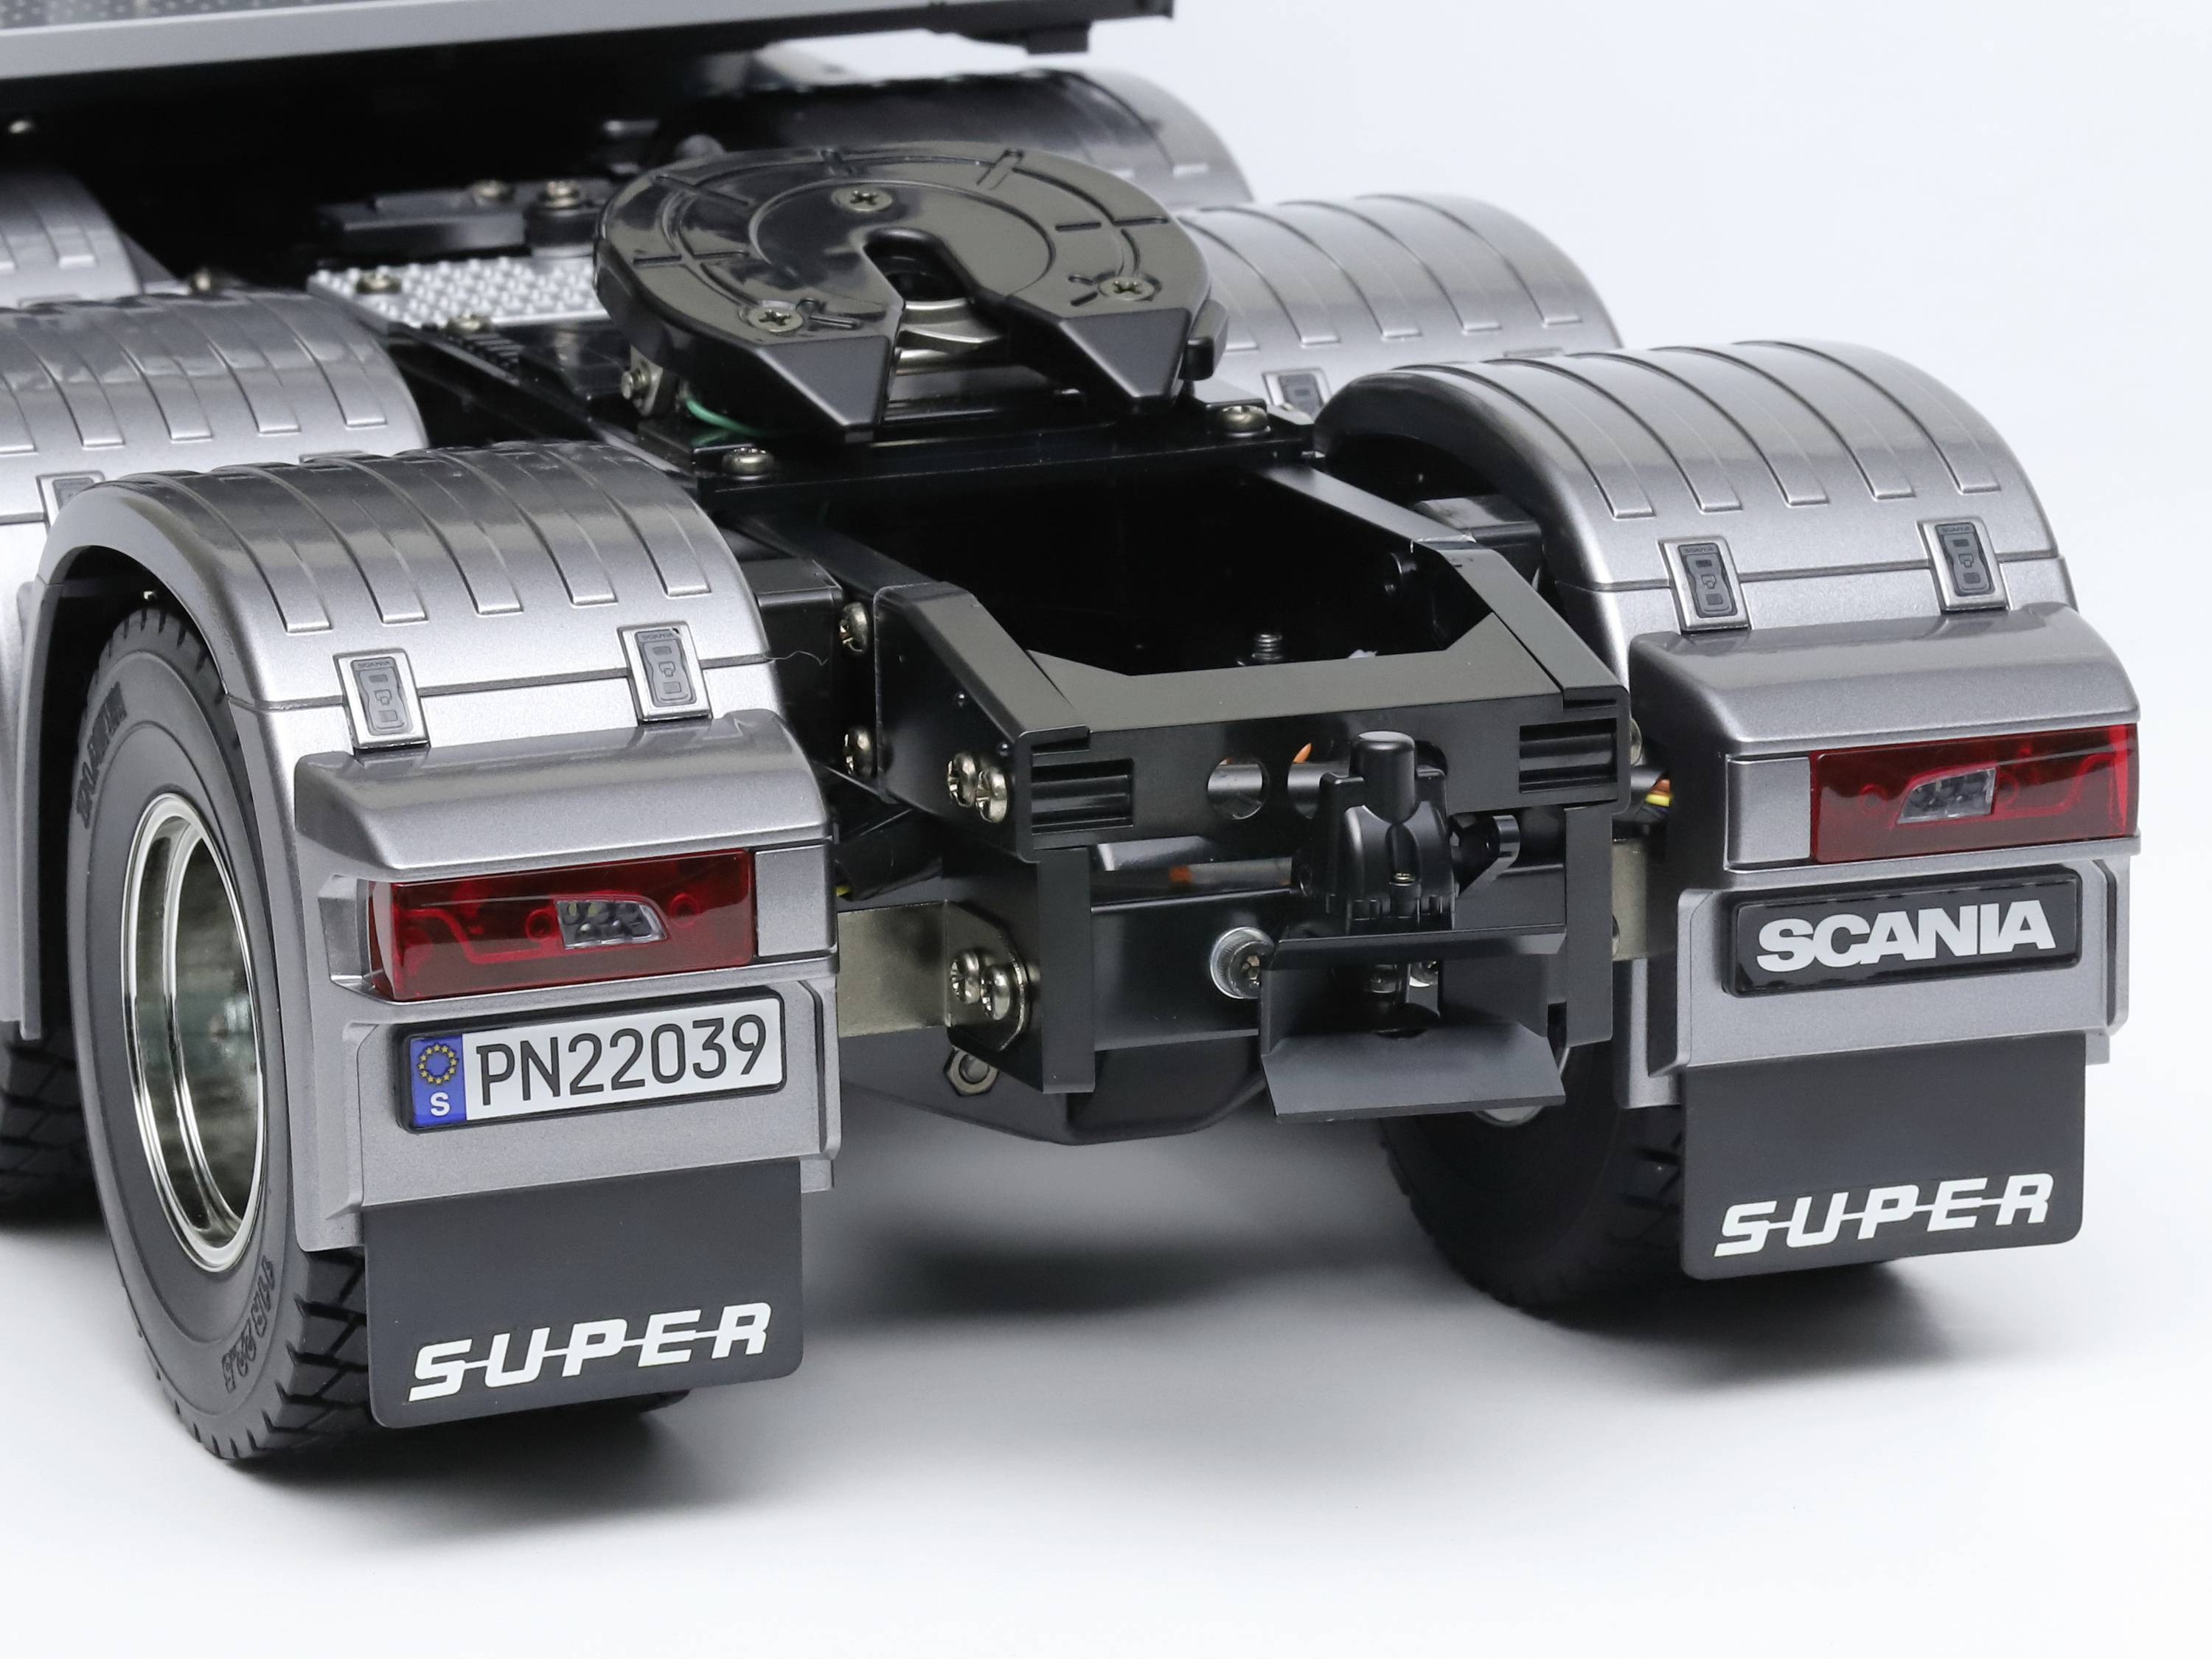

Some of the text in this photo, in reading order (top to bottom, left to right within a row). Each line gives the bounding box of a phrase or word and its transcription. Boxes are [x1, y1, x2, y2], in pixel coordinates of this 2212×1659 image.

[357, 660, 391, 668] SCANIA
[1756, 900, 2057, 973] SCANIA
[475, 1013, 767, 1107] PN22039
[430, 1091, 451, 1118] S
[1714, 1172, 2055, 1257] SUPER
[408, 1301, 773, 1402] SUPER
